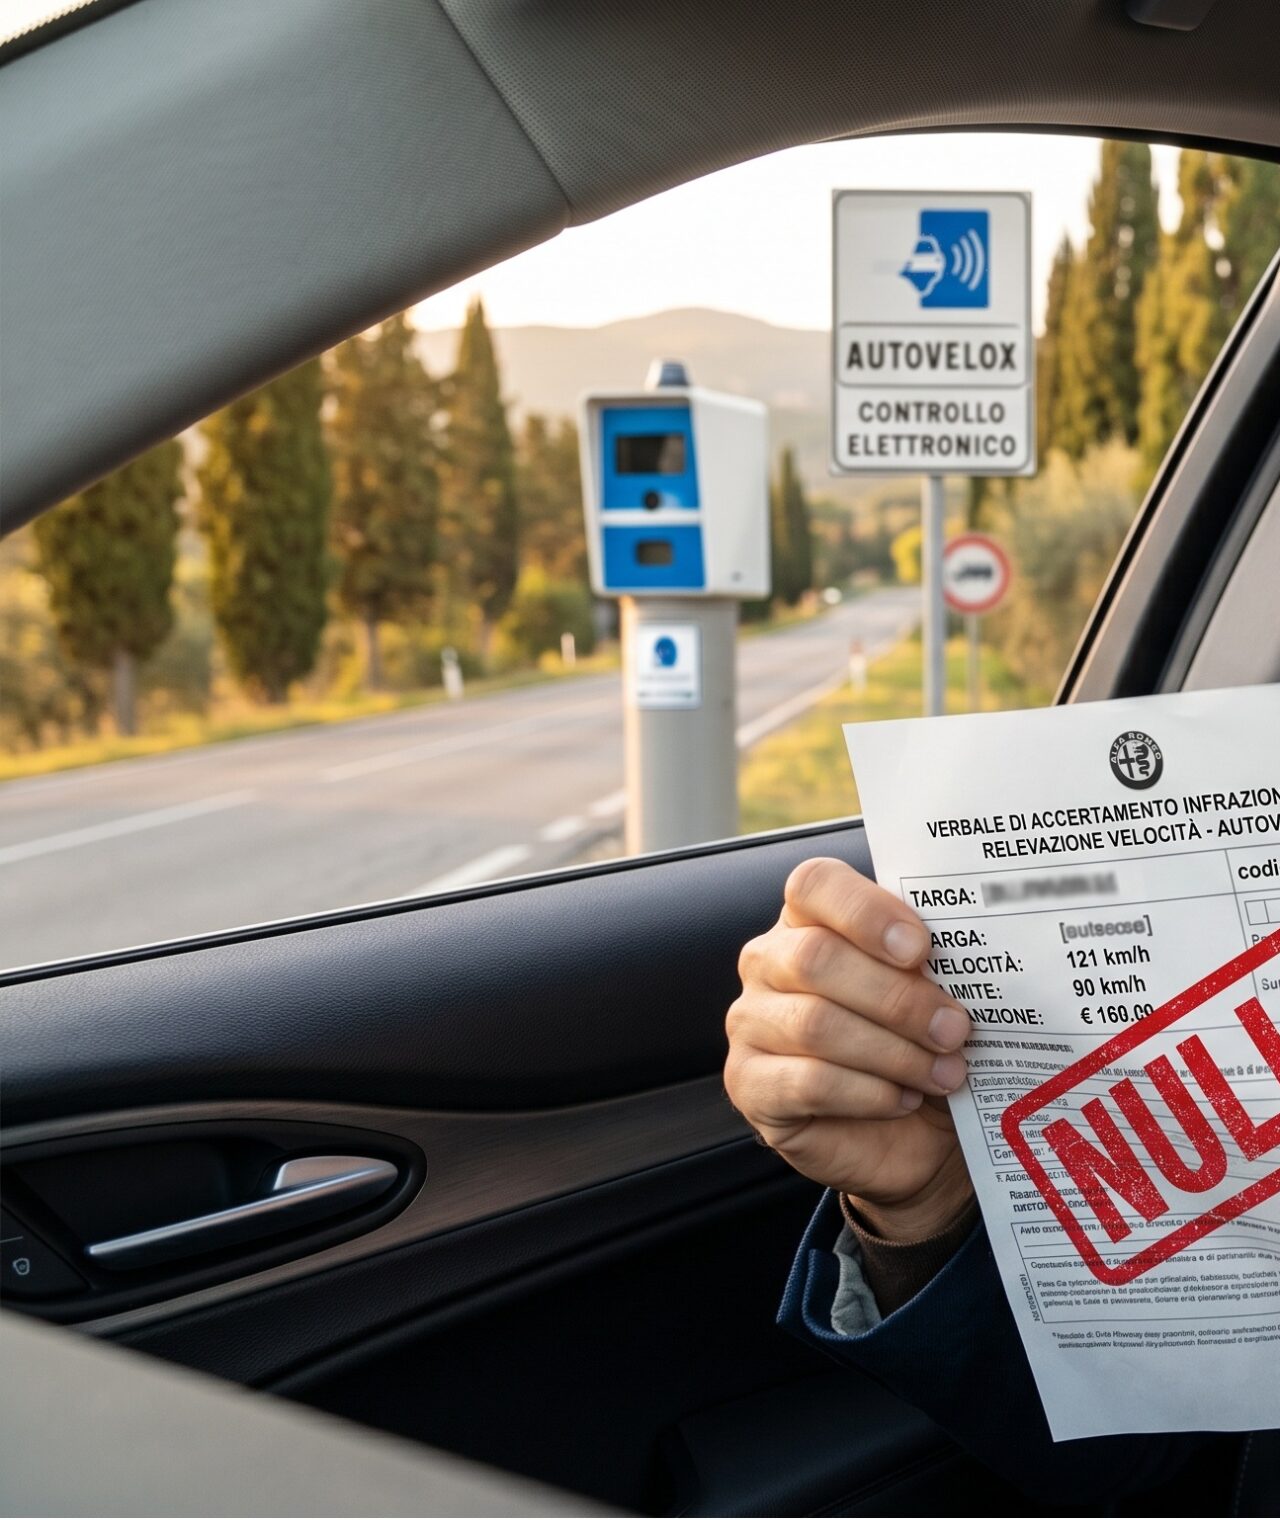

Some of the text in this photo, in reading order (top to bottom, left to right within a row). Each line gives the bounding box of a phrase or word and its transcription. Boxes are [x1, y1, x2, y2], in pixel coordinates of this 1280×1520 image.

[847, 341, 1017, 371] AUTOVELOX
[858, 401, 1006, 424] CONTROLLO
[847, 433, 1017, 457] ELETTRONICO
[926, 815, 1006, 838] VERBALE
[1009, 813, 1028, 831] DI
[1031, 799, 1178, 829] ACCERTAMENTO
[981, 832, 1105, 859] RELEVAZIONE
[1107, 818, 1203, 847] VELOCITÀ
[910, 887, 977, 908] TARGA:
[931, 929, 988, 949] ARGA:
[927, 945, 1151, 976] VELOCITÀ: 121 km/h
[1072, 978, 1095, 997] 90
[1100, 974, 1146, 995] km/h
[1080, 1007, 1093, 1025] €
